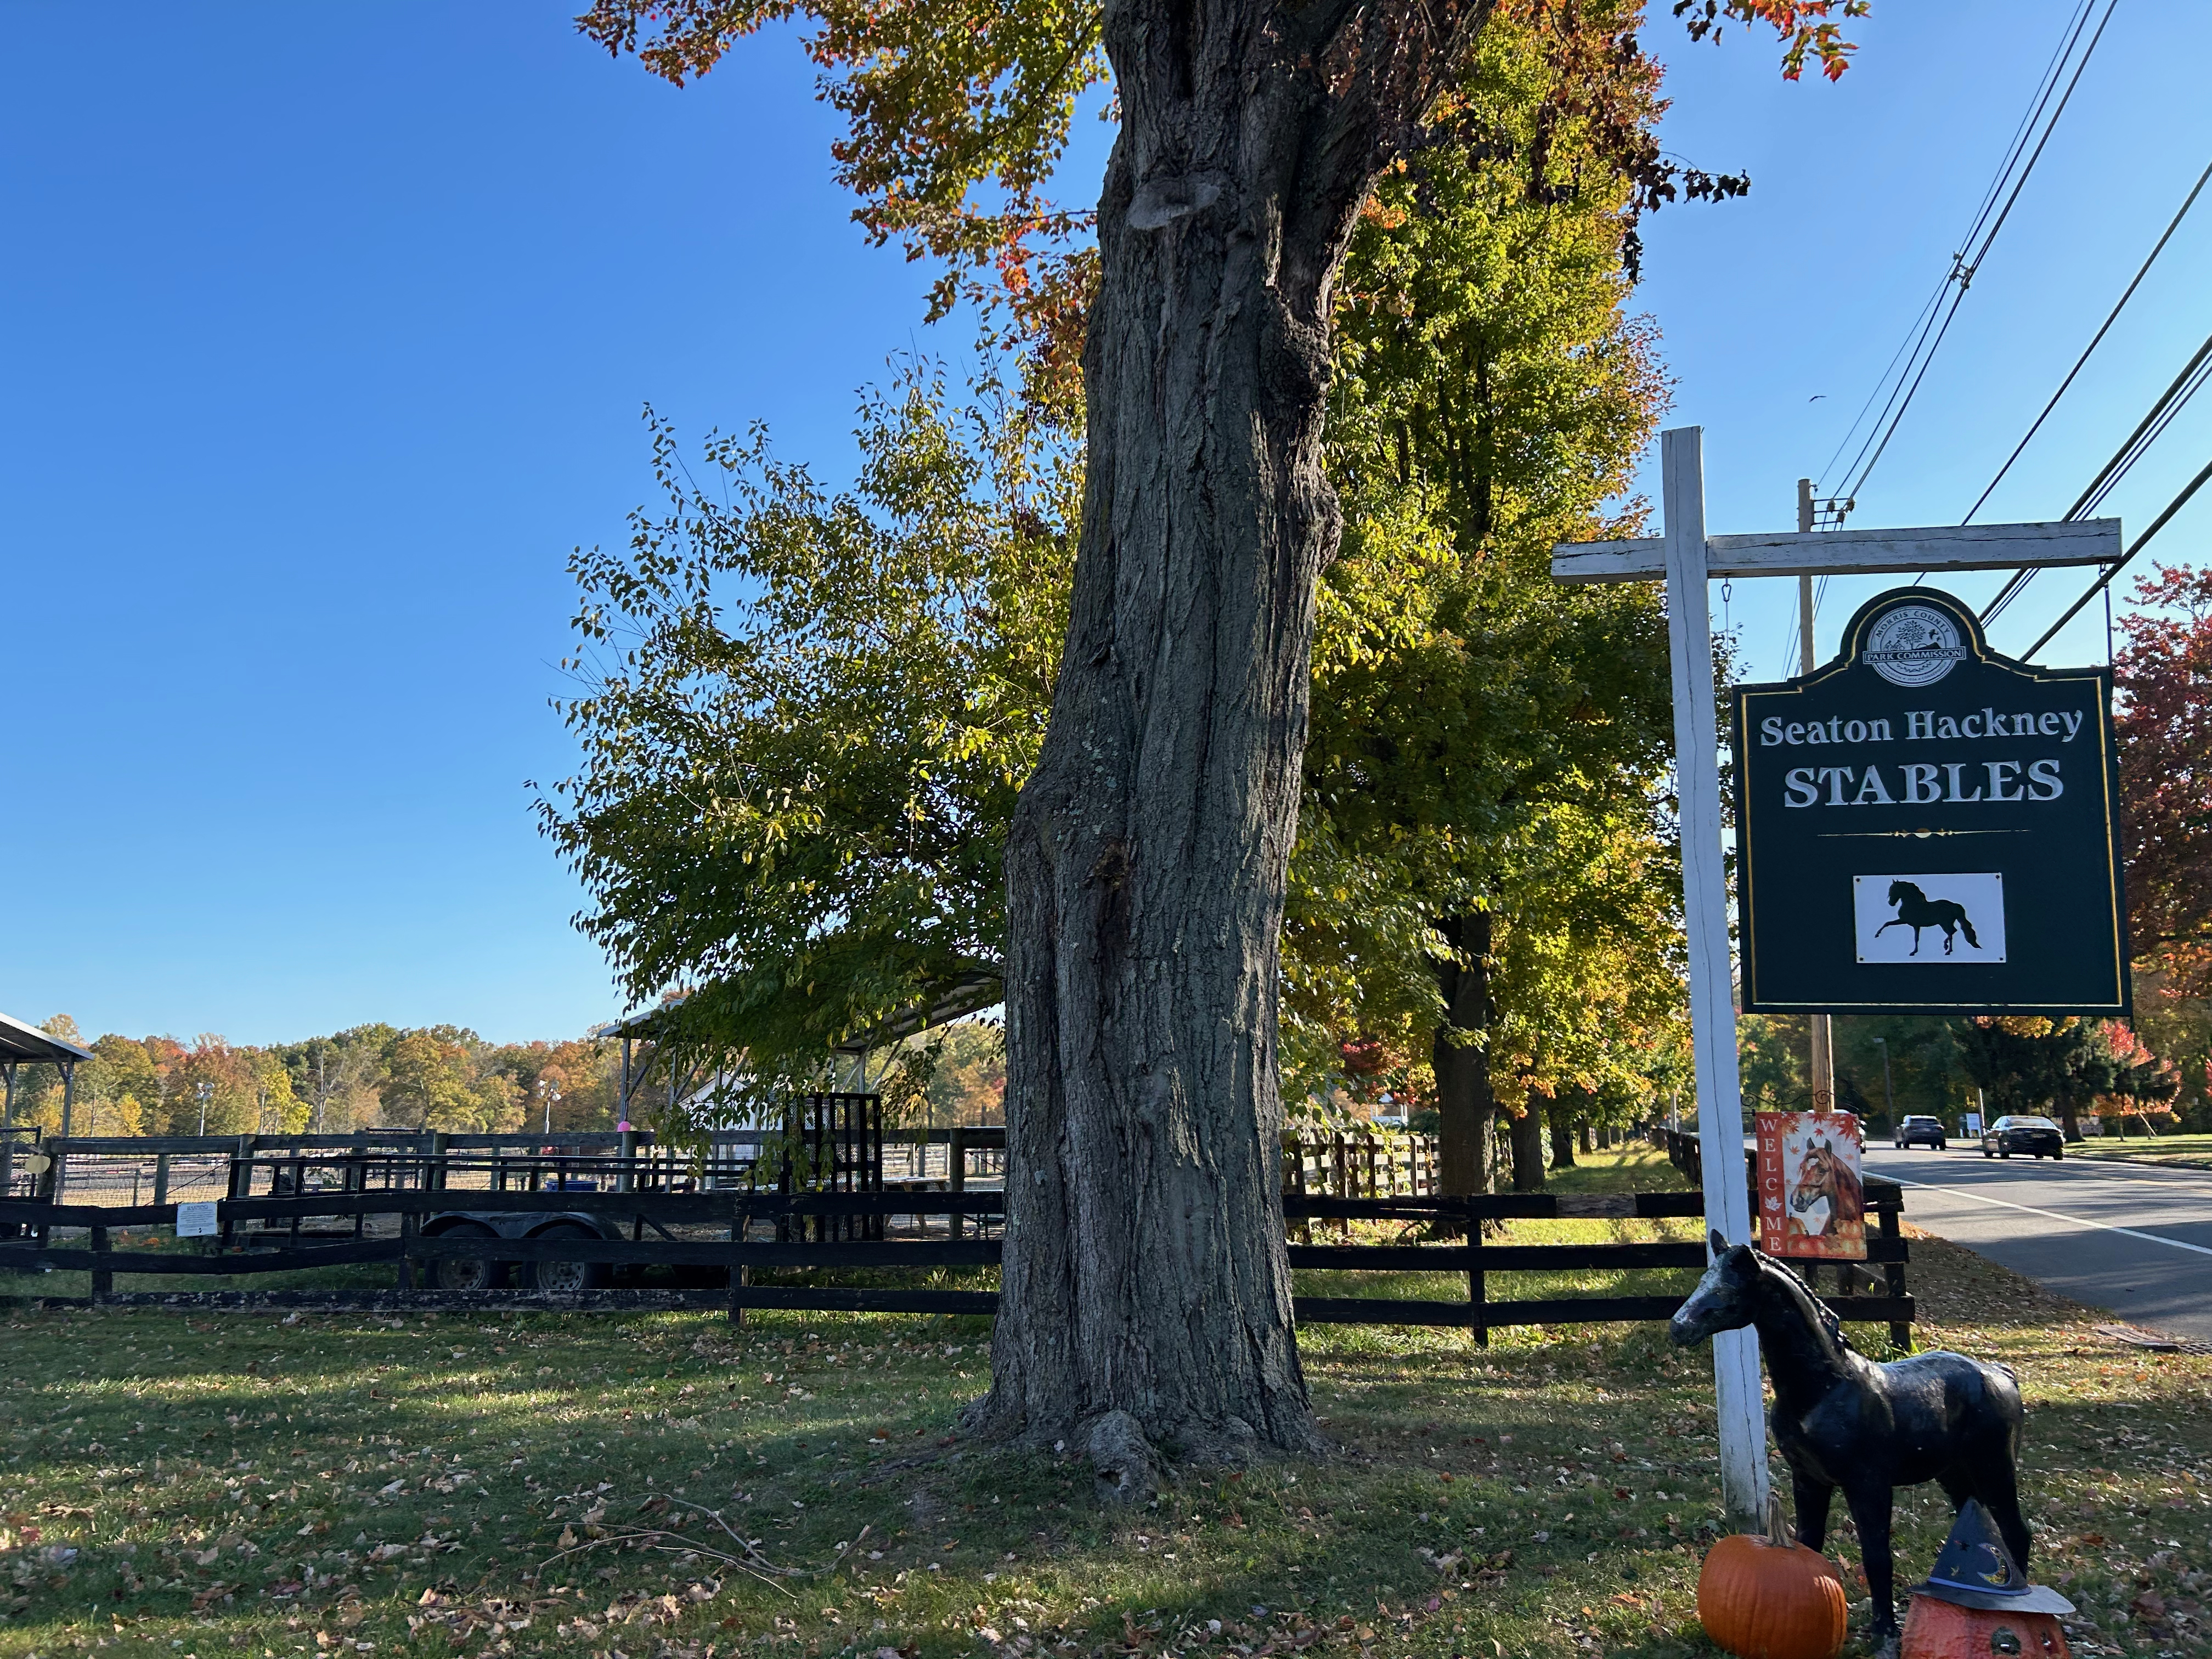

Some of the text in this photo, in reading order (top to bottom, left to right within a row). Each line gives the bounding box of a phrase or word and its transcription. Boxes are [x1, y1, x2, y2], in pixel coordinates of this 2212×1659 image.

[1876, 610, 1950, 638] MORRIS COUNTY
[1867, 650, 1962, 661] PARK COMMISSION
[1760, 707, 2083, 746] Seaton Hackney
[1784, 759, 2064, 808] STABLES
